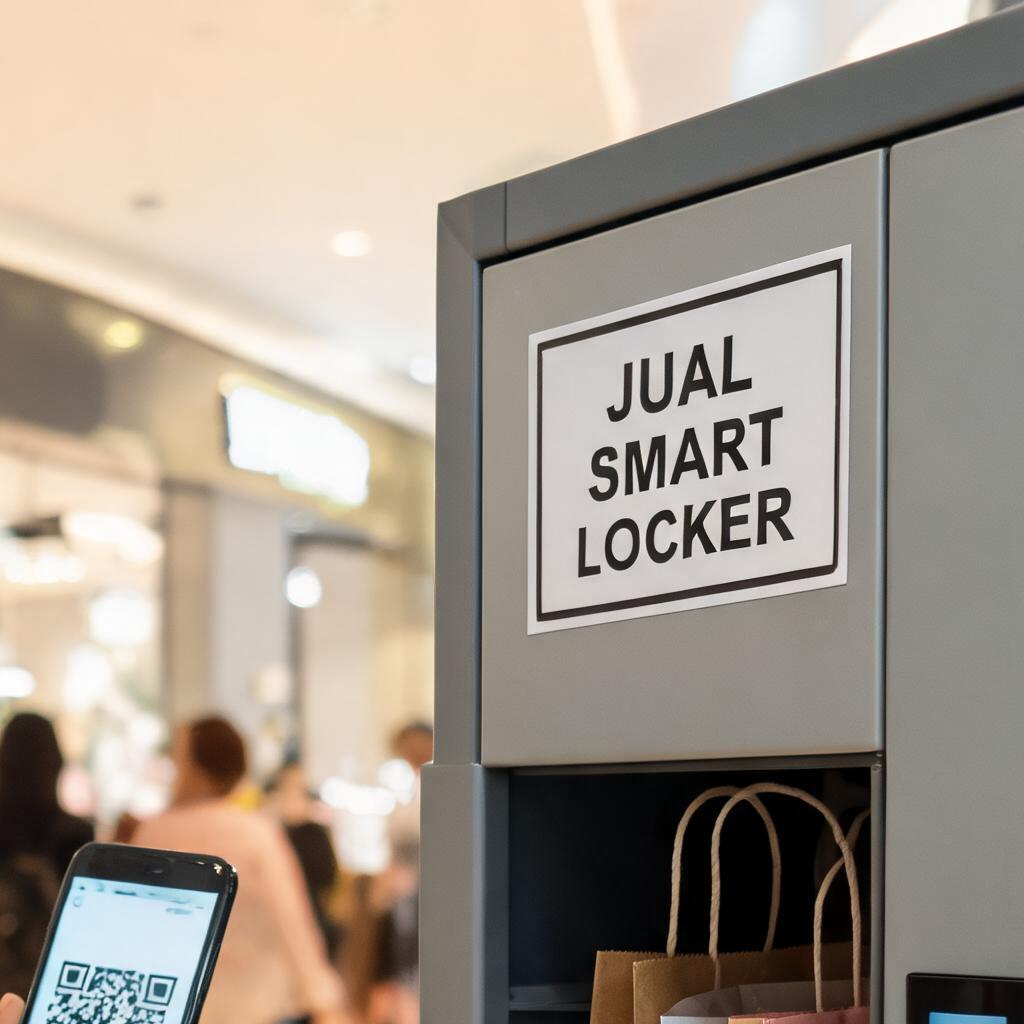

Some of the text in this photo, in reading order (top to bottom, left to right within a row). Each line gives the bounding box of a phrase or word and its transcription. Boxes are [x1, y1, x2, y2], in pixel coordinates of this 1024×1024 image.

[606, 335, 753, 422] JUAL
[588, 406, 784, 502] SMART
[577, 487, 795, 578] LOCKER
